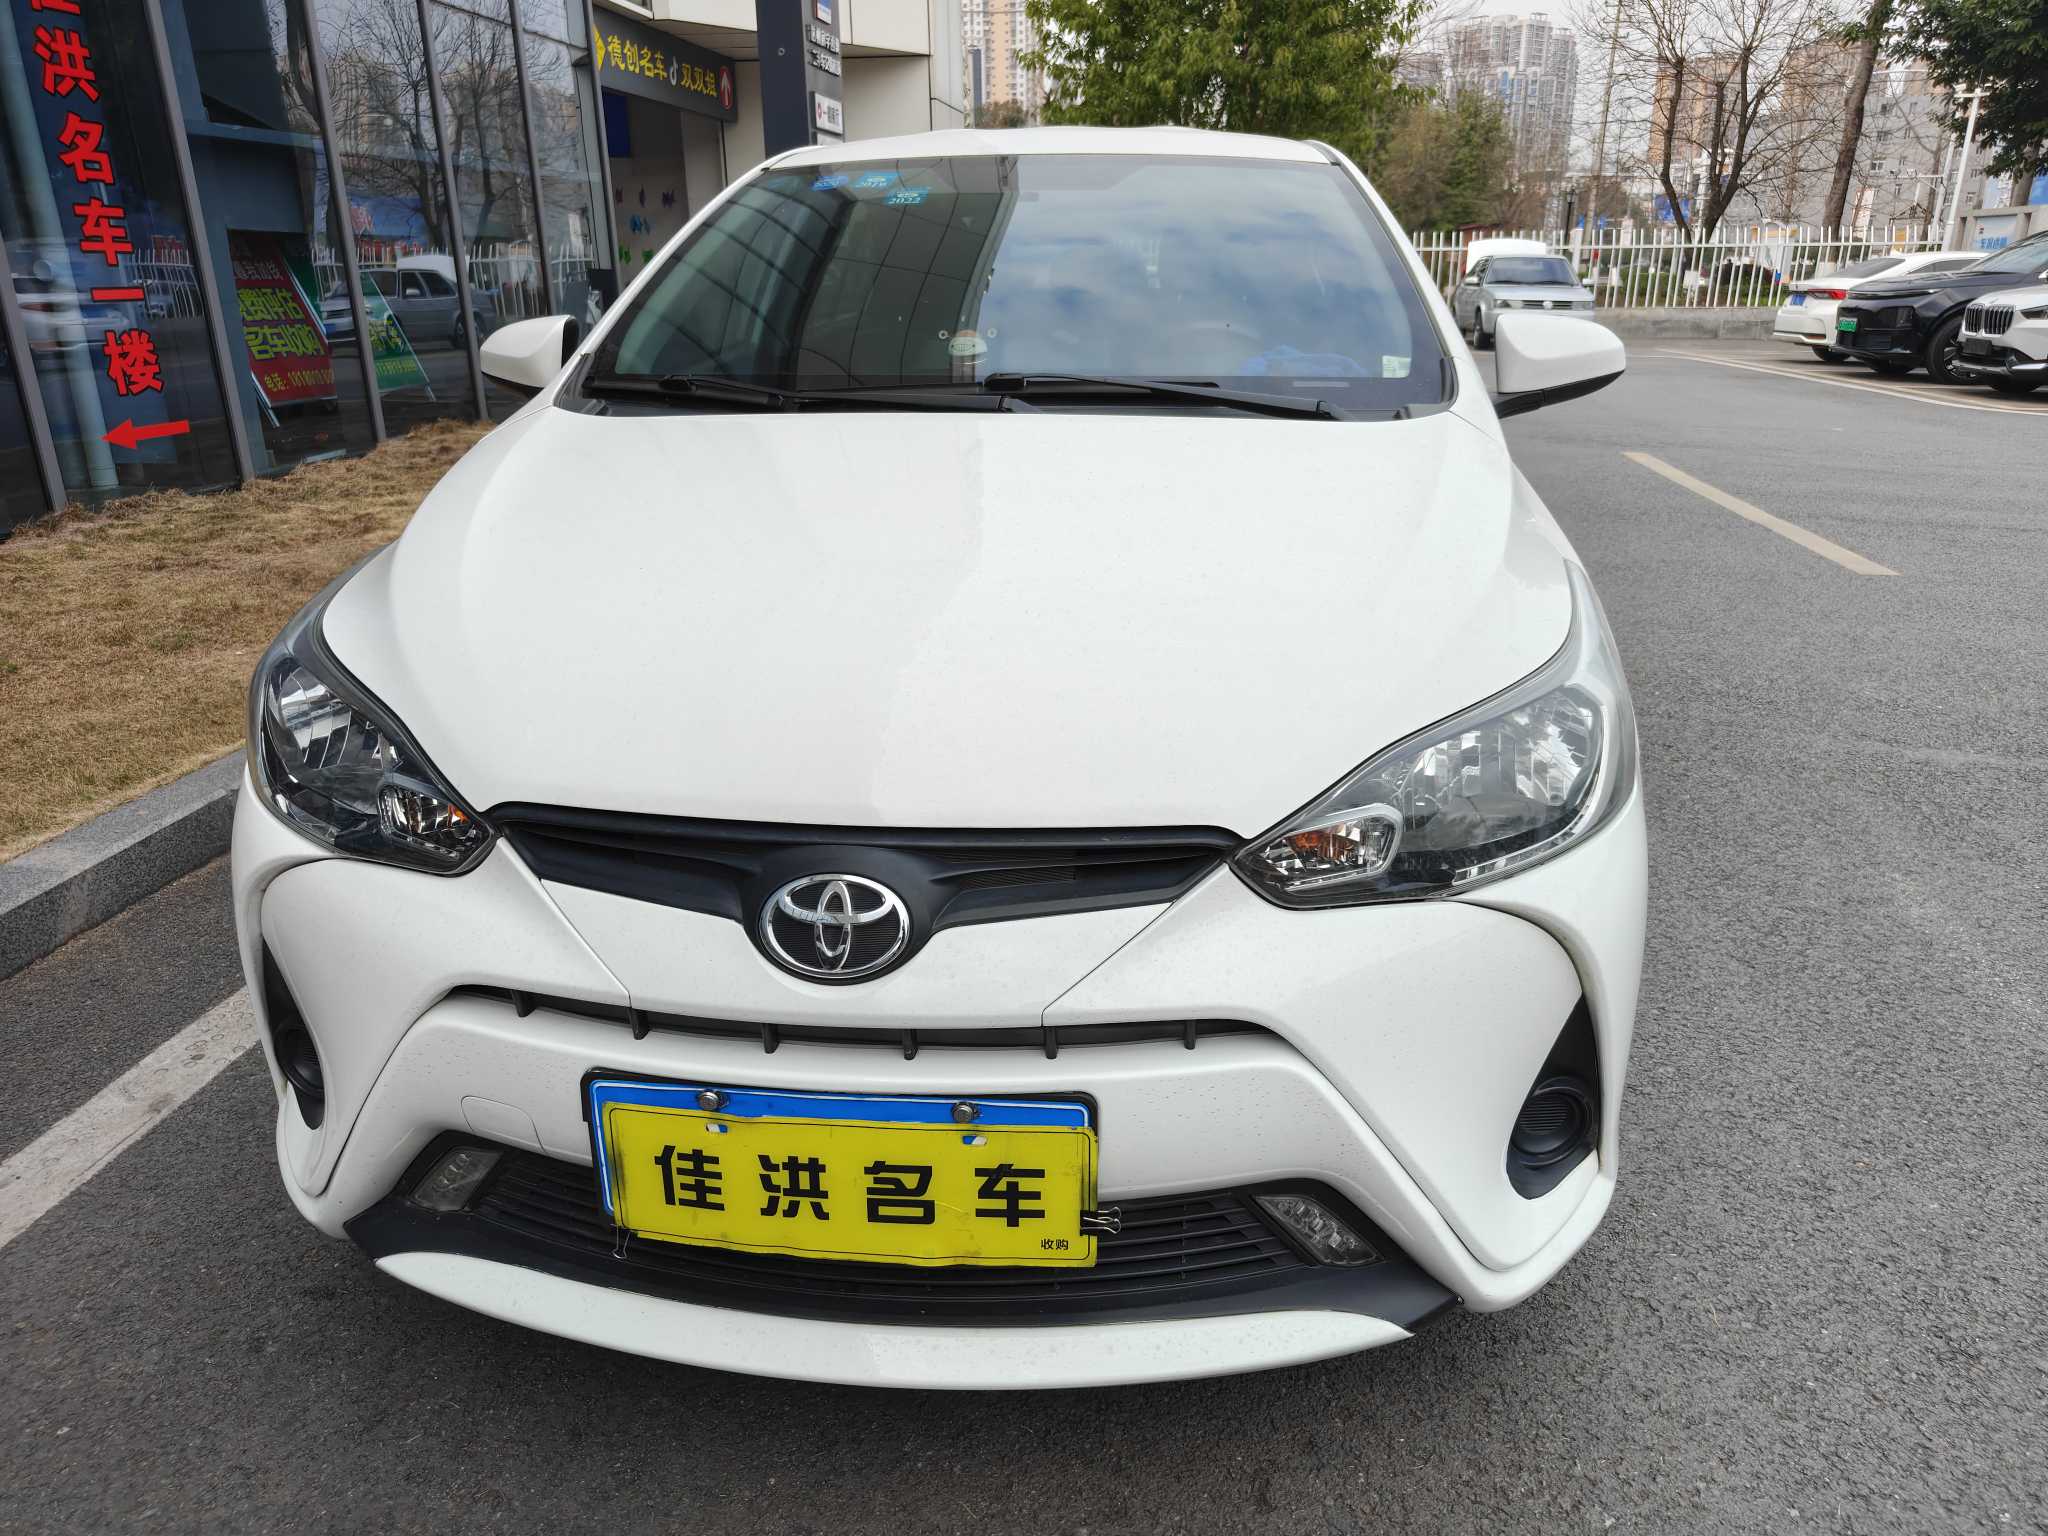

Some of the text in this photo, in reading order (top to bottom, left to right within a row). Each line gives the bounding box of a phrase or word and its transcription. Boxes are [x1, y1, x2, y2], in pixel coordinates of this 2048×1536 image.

[31, 0, 165, 396] 洪名车一楼
[654, 1145, 1046, 1228] 佳洪名车
[1040, 1238, 1069, 1251] 收购
